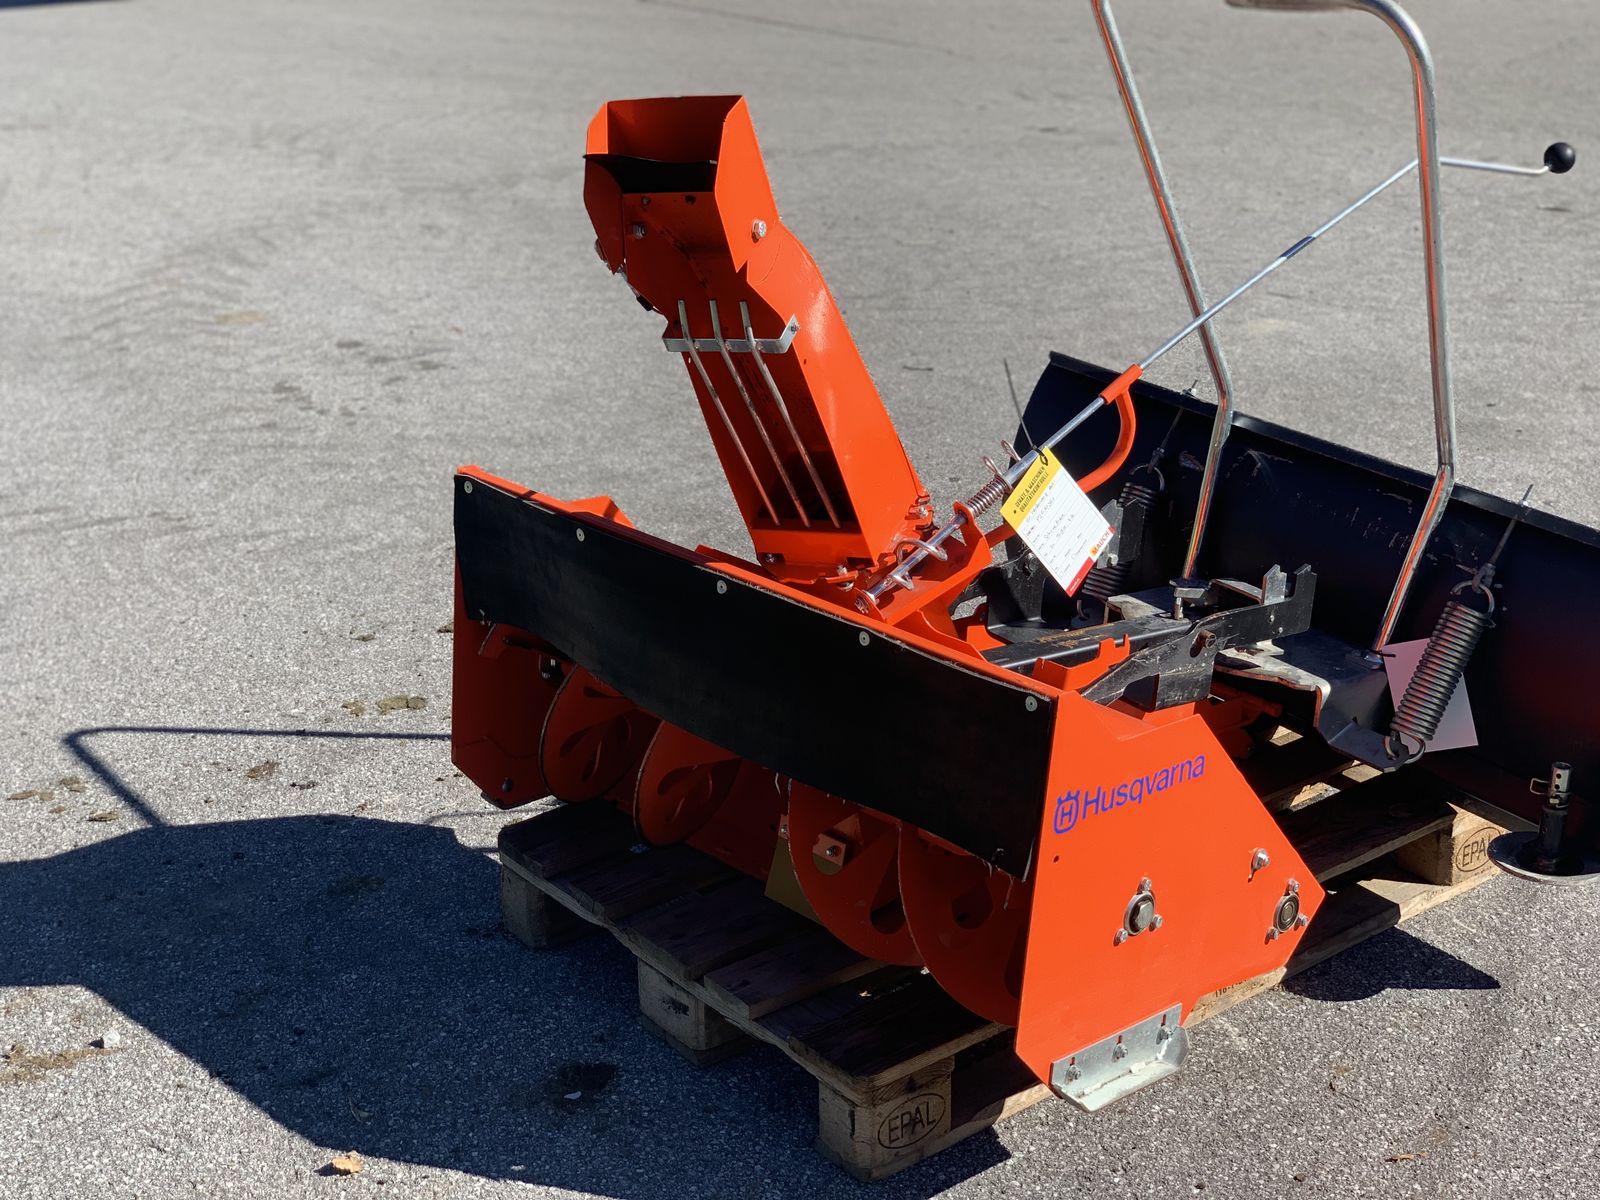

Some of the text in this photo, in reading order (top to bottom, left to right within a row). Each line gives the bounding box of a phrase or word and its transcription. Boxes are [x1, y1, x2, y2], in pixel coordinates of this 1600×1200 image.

[1092, 530, 1109, 555] MAUCH
[1082, 754, 1205, 820] Husqvarna
[888, 1101, 936, 1144] EPAL
